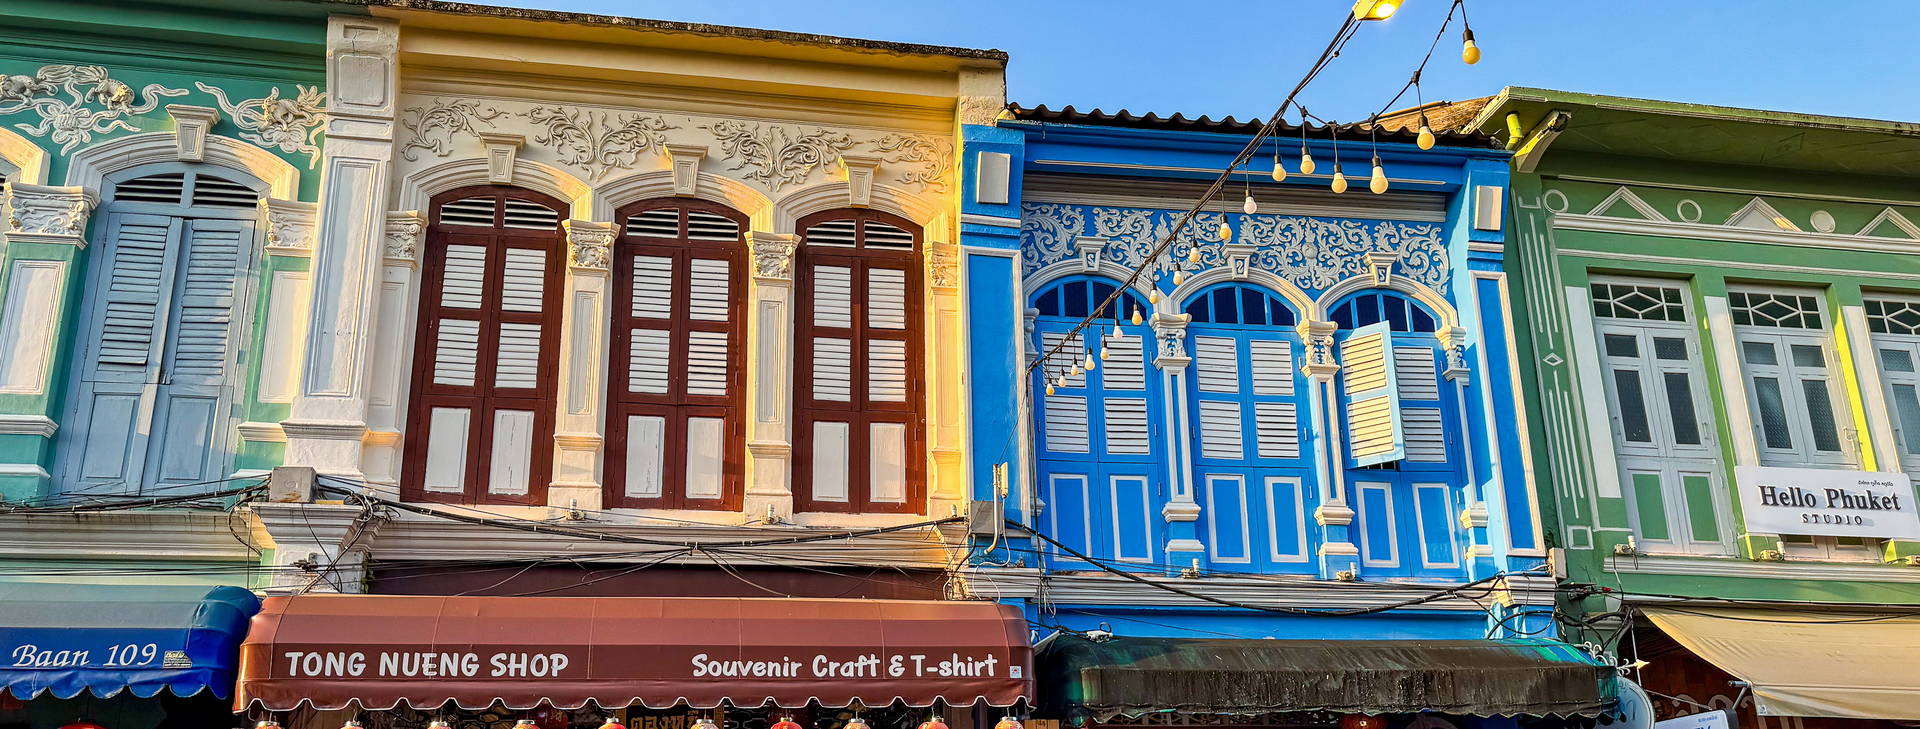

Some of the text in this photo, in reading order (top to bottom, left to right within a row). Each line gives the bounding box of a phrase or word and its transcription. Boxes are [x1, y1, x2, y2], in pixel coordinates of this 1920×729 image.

[1758, 485, 1902, 511] Hello Phuket
[1802, 513, 1863, 526] STUDIO
[12, 644, 90, 667] Baan
[103, 643, 157, 666] 109
[284, 651, 569, 677] TONG NUENG SHOP
[691, 653, 998, 678] Souvenir Craft & T-shirt
